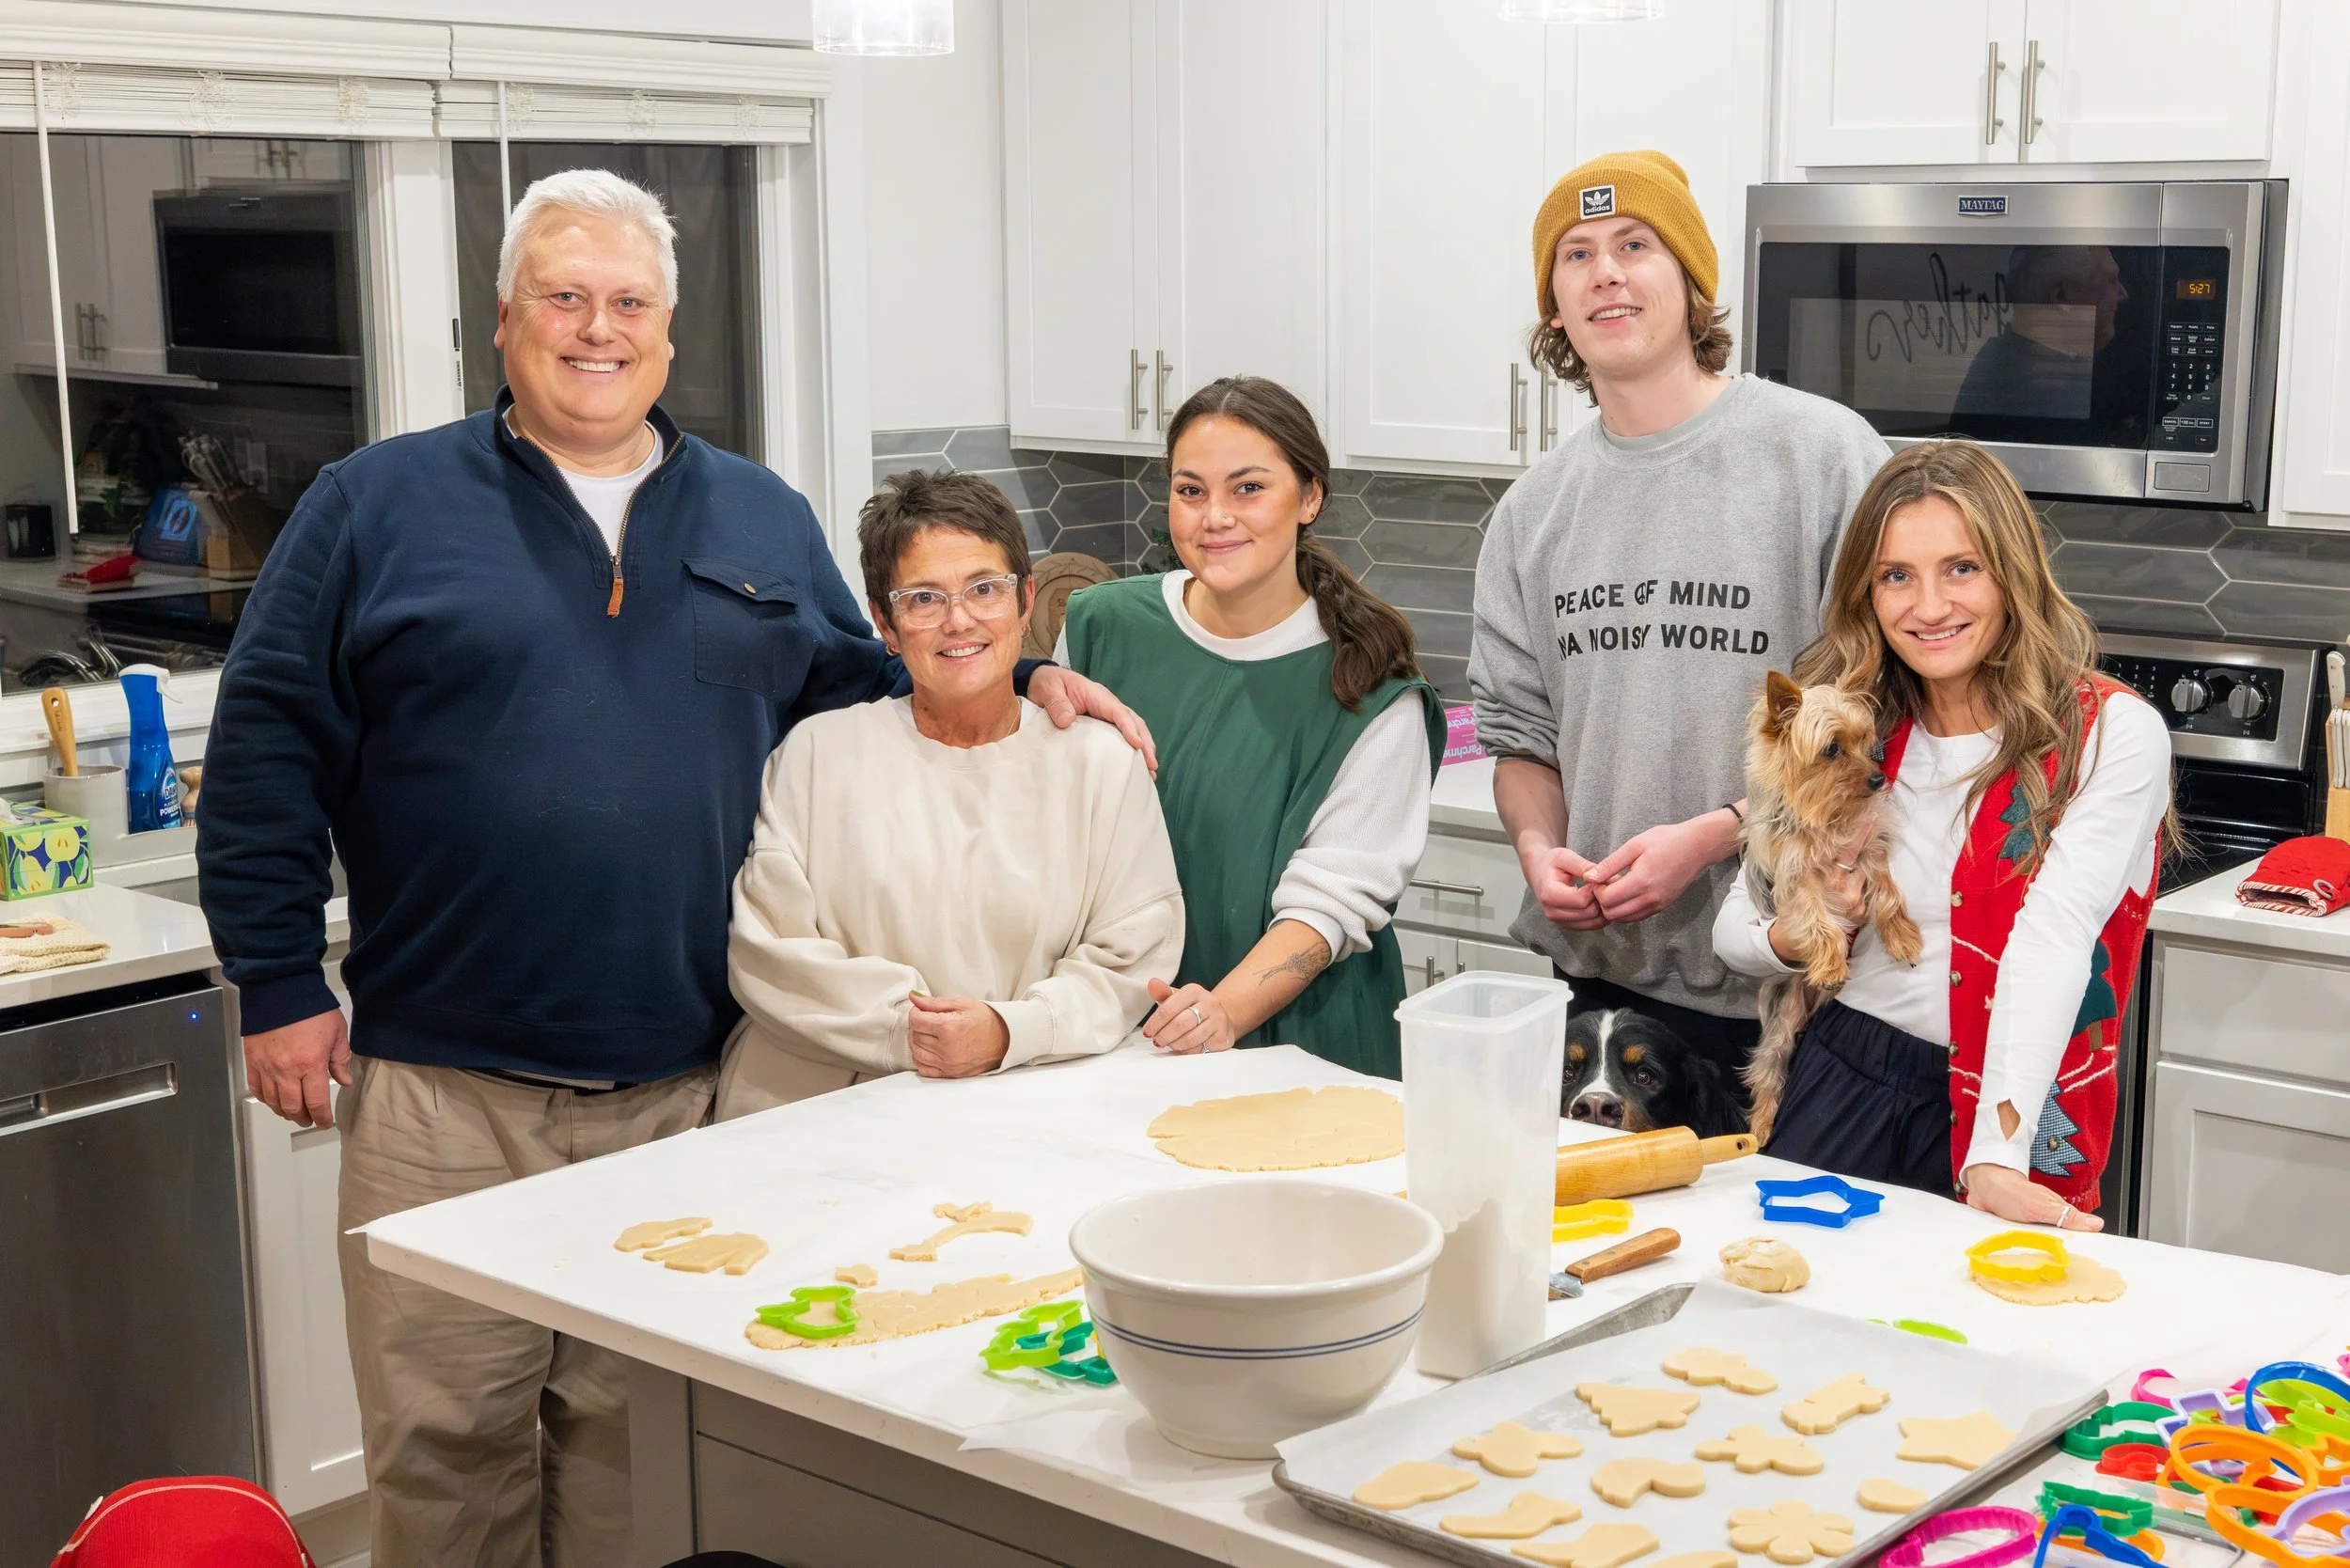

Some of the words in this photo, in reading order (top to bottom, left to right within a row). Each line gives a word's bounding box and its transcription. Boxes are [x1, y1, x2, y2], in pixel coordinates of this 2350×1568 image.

[1585, 205, 1610, 214] adidas
[1961, 199, 2005, 211] MAYTAG
[2189, 283, 2210, 294] 5:27
[1554, 583, 1624, 619] PEACE
[1668, 580, 1751, 610] MIND
[1589, 624, 1652, 651] NOISY
[1660, 623, 1769, 655] WORLD
[1443, 744, 1482, 758] Parchme
[164, 785, 178, 798] DAW
